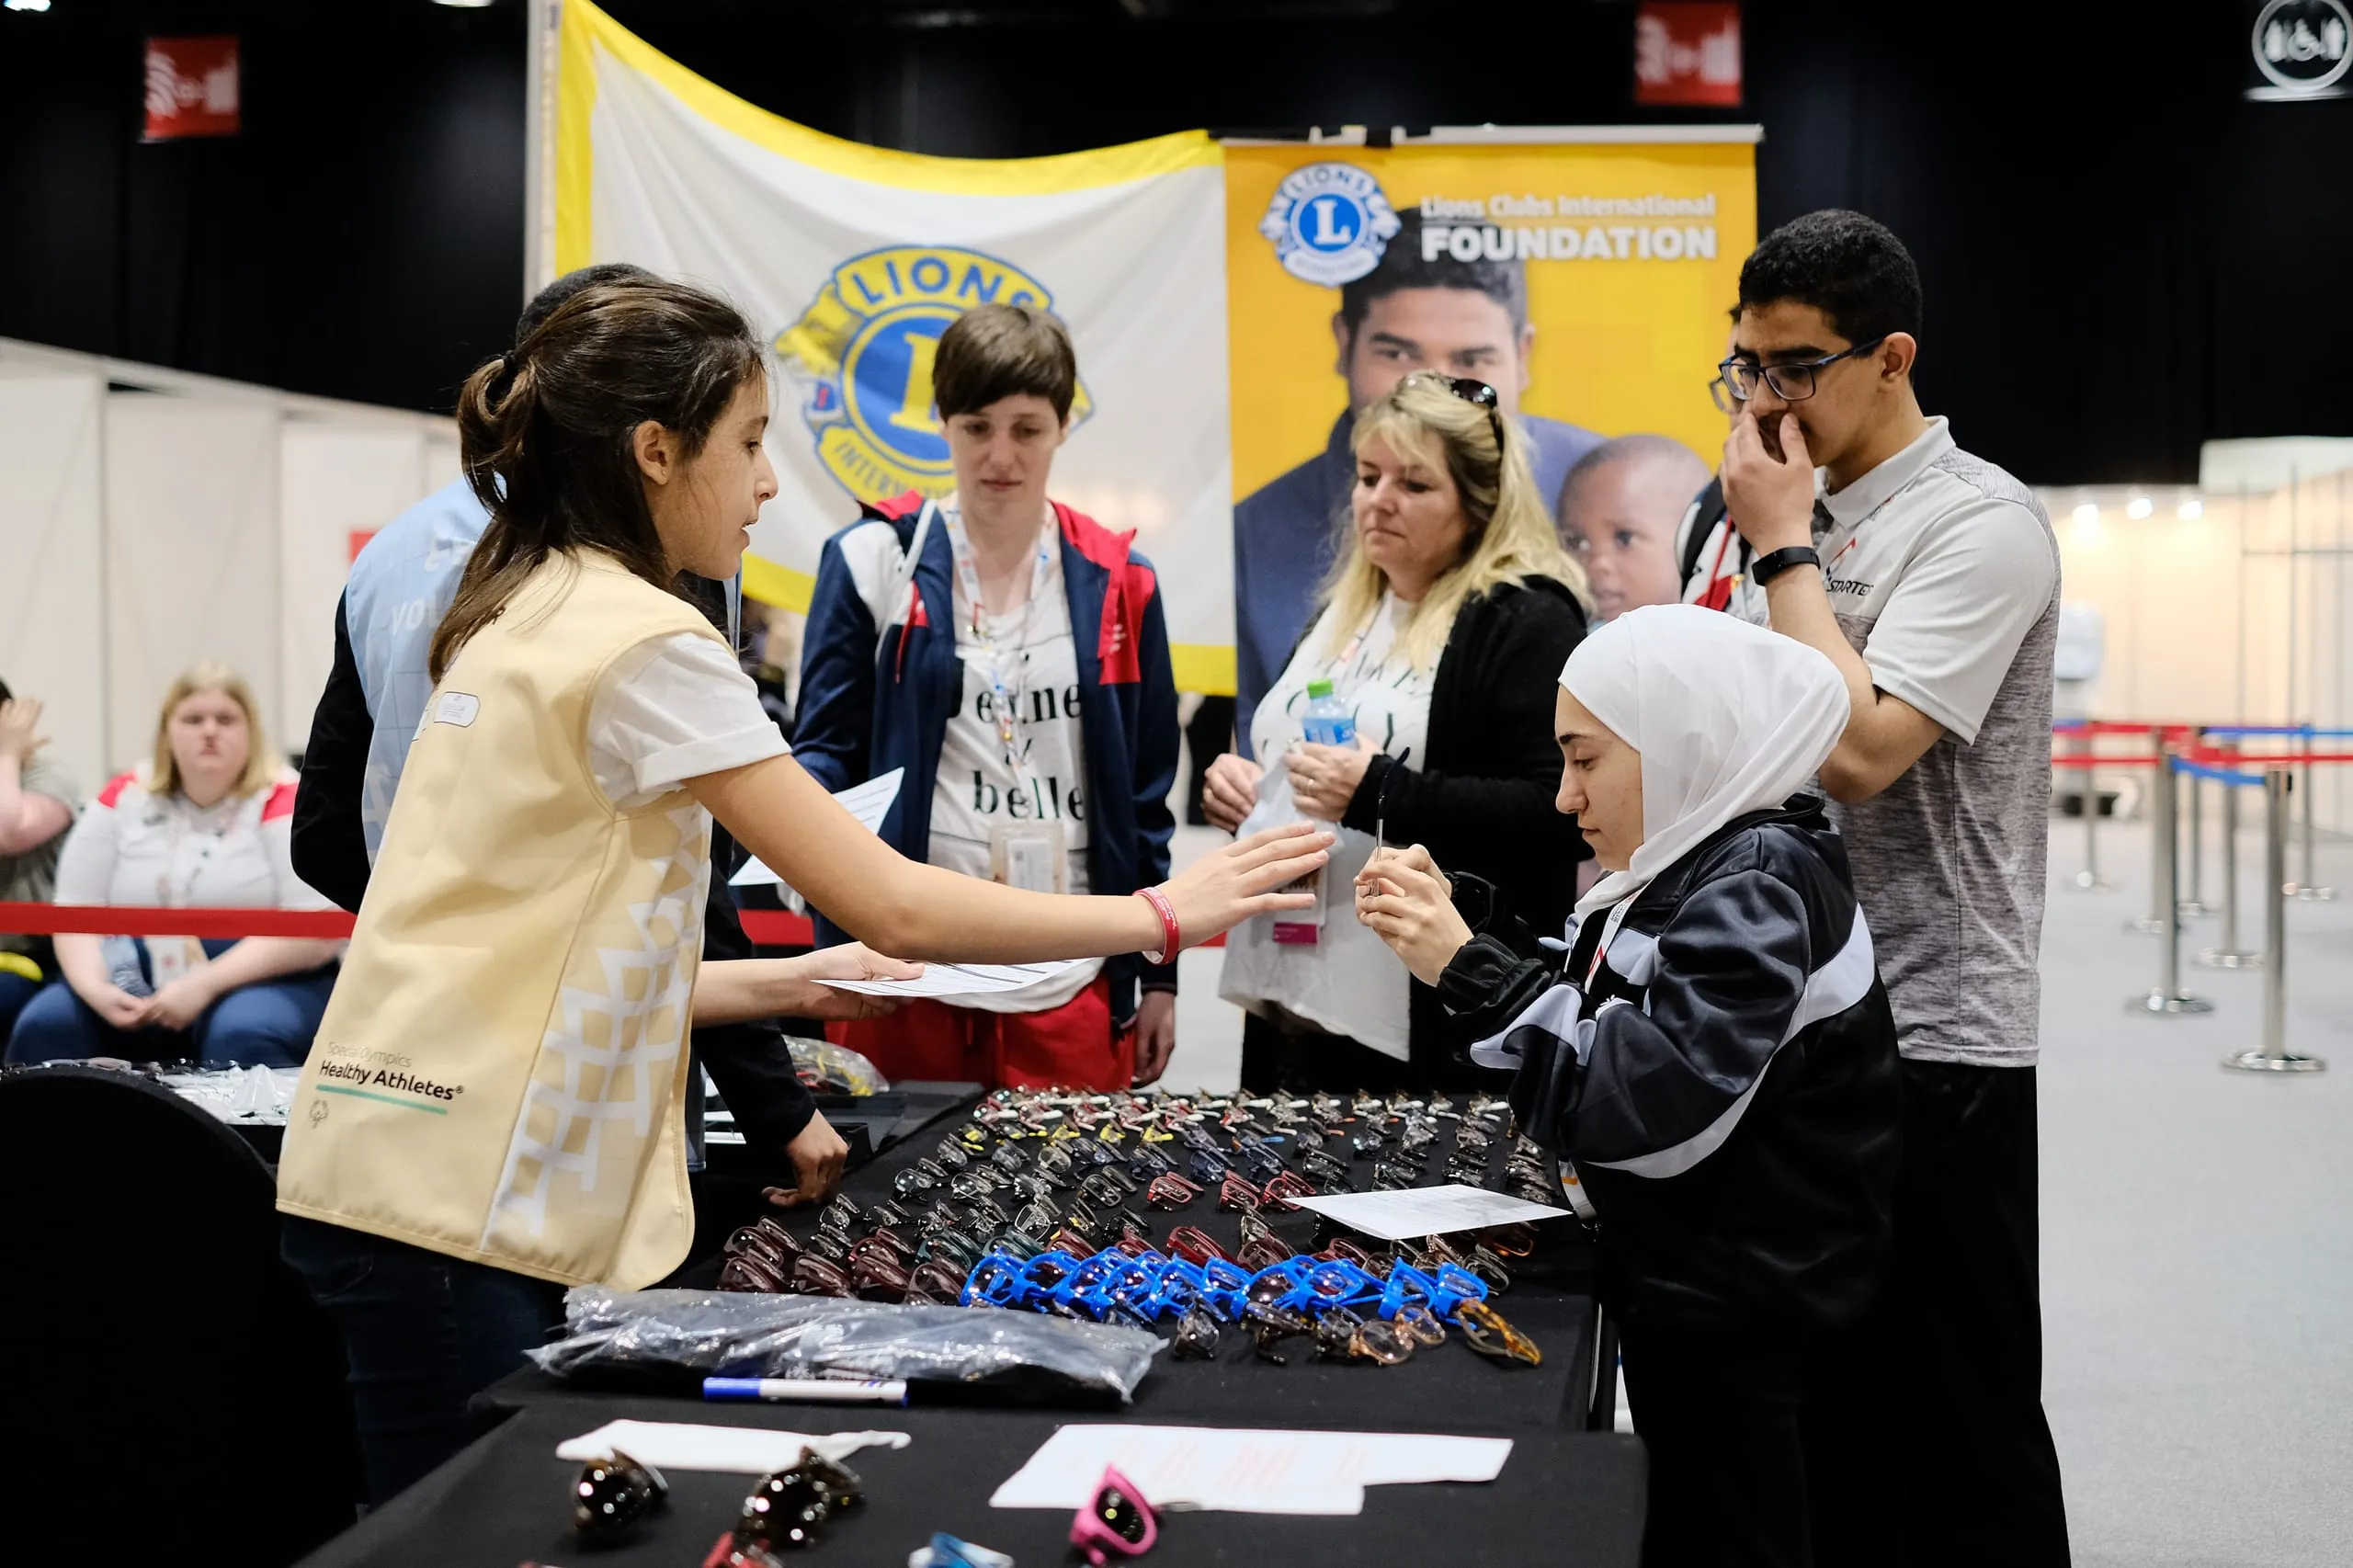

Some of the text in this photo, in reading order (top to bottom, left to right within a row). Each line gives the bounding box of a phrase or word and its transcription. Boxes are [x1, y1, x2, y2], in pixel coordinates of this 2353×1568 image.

[1421, 227, 1716, 262] FOUNDATION
[971, 770, 1085, 821] belle
[319, 1059, 371, 1085] Healthy
